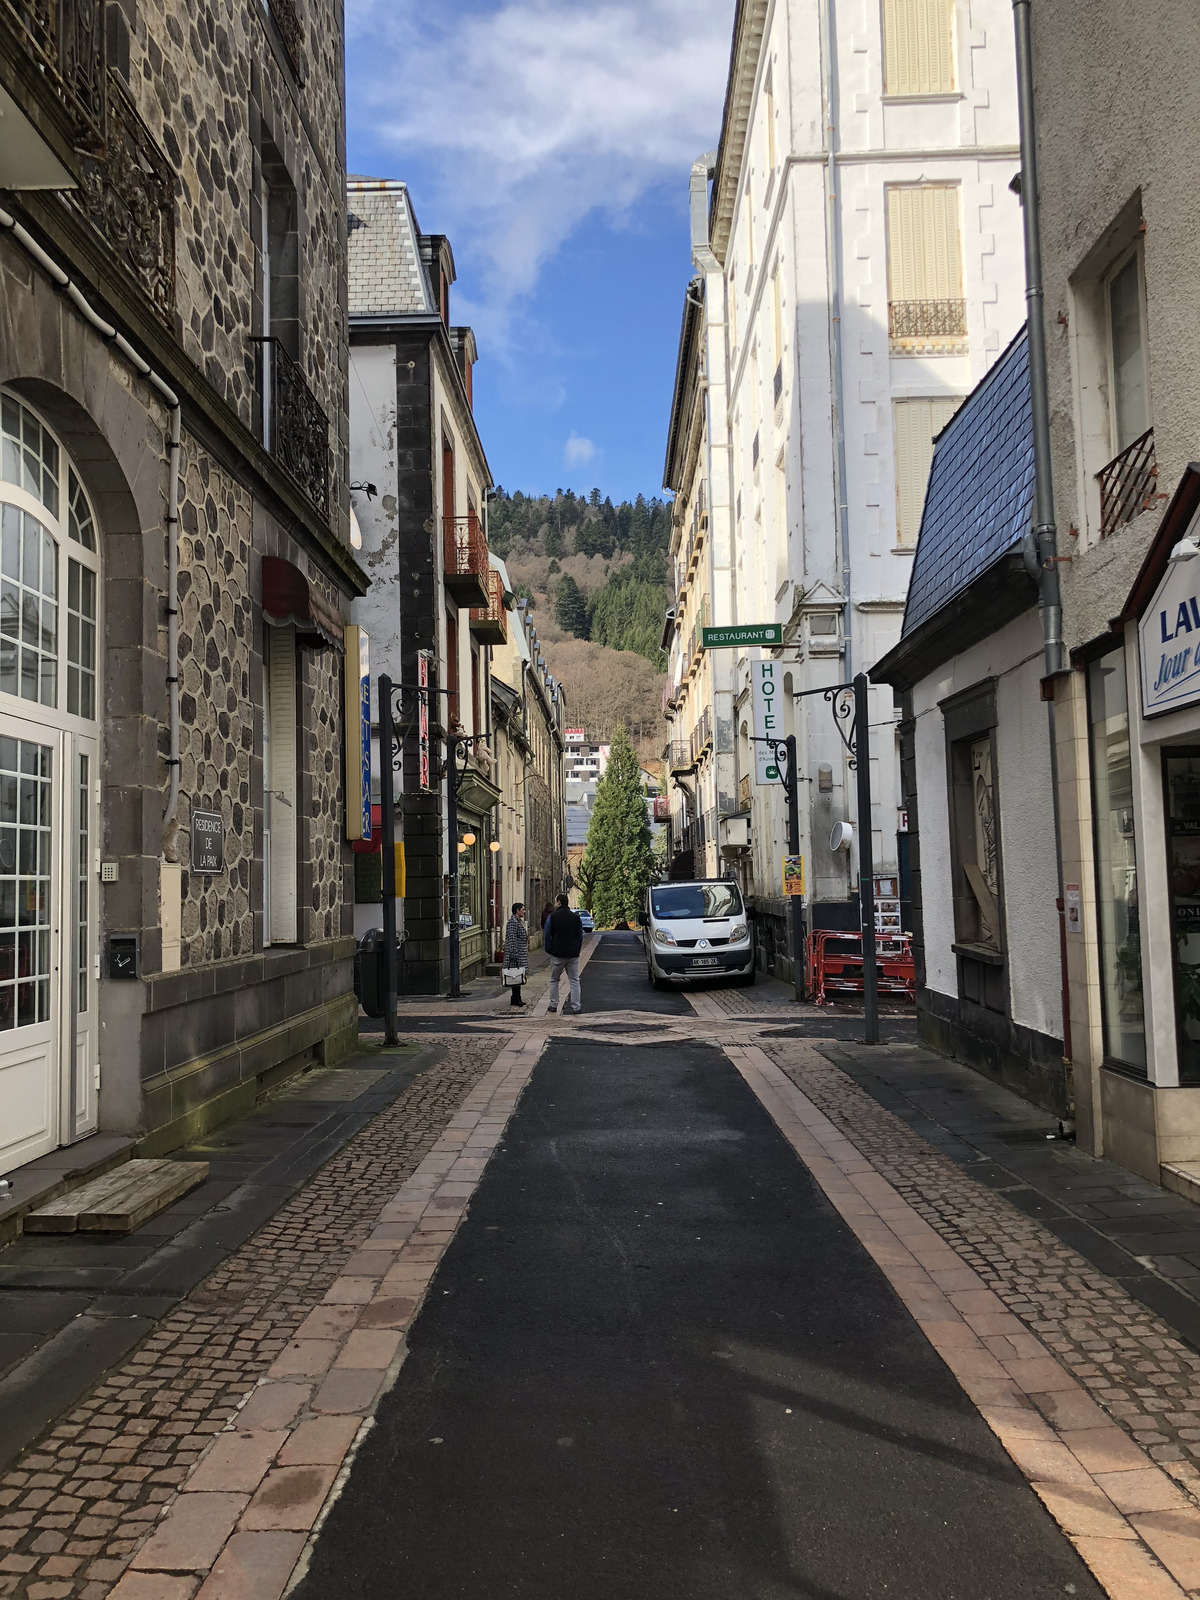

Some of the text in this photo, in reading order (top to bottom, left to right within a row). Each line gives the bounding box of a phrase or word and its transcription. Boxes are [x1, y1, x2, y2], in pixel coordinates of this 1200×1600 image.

[707, 630, 764, 642] RESTAURANT
[1153, 646, 1191, 691] Jour
[761, 663, 776, 747] HOTEL
[420, 657, 428, 786] BAR
[195, 818, 221, 834] RESIDENCE
[205, 837, 212, 850] DE
[200, 855, 217, 868] LA PAIX
